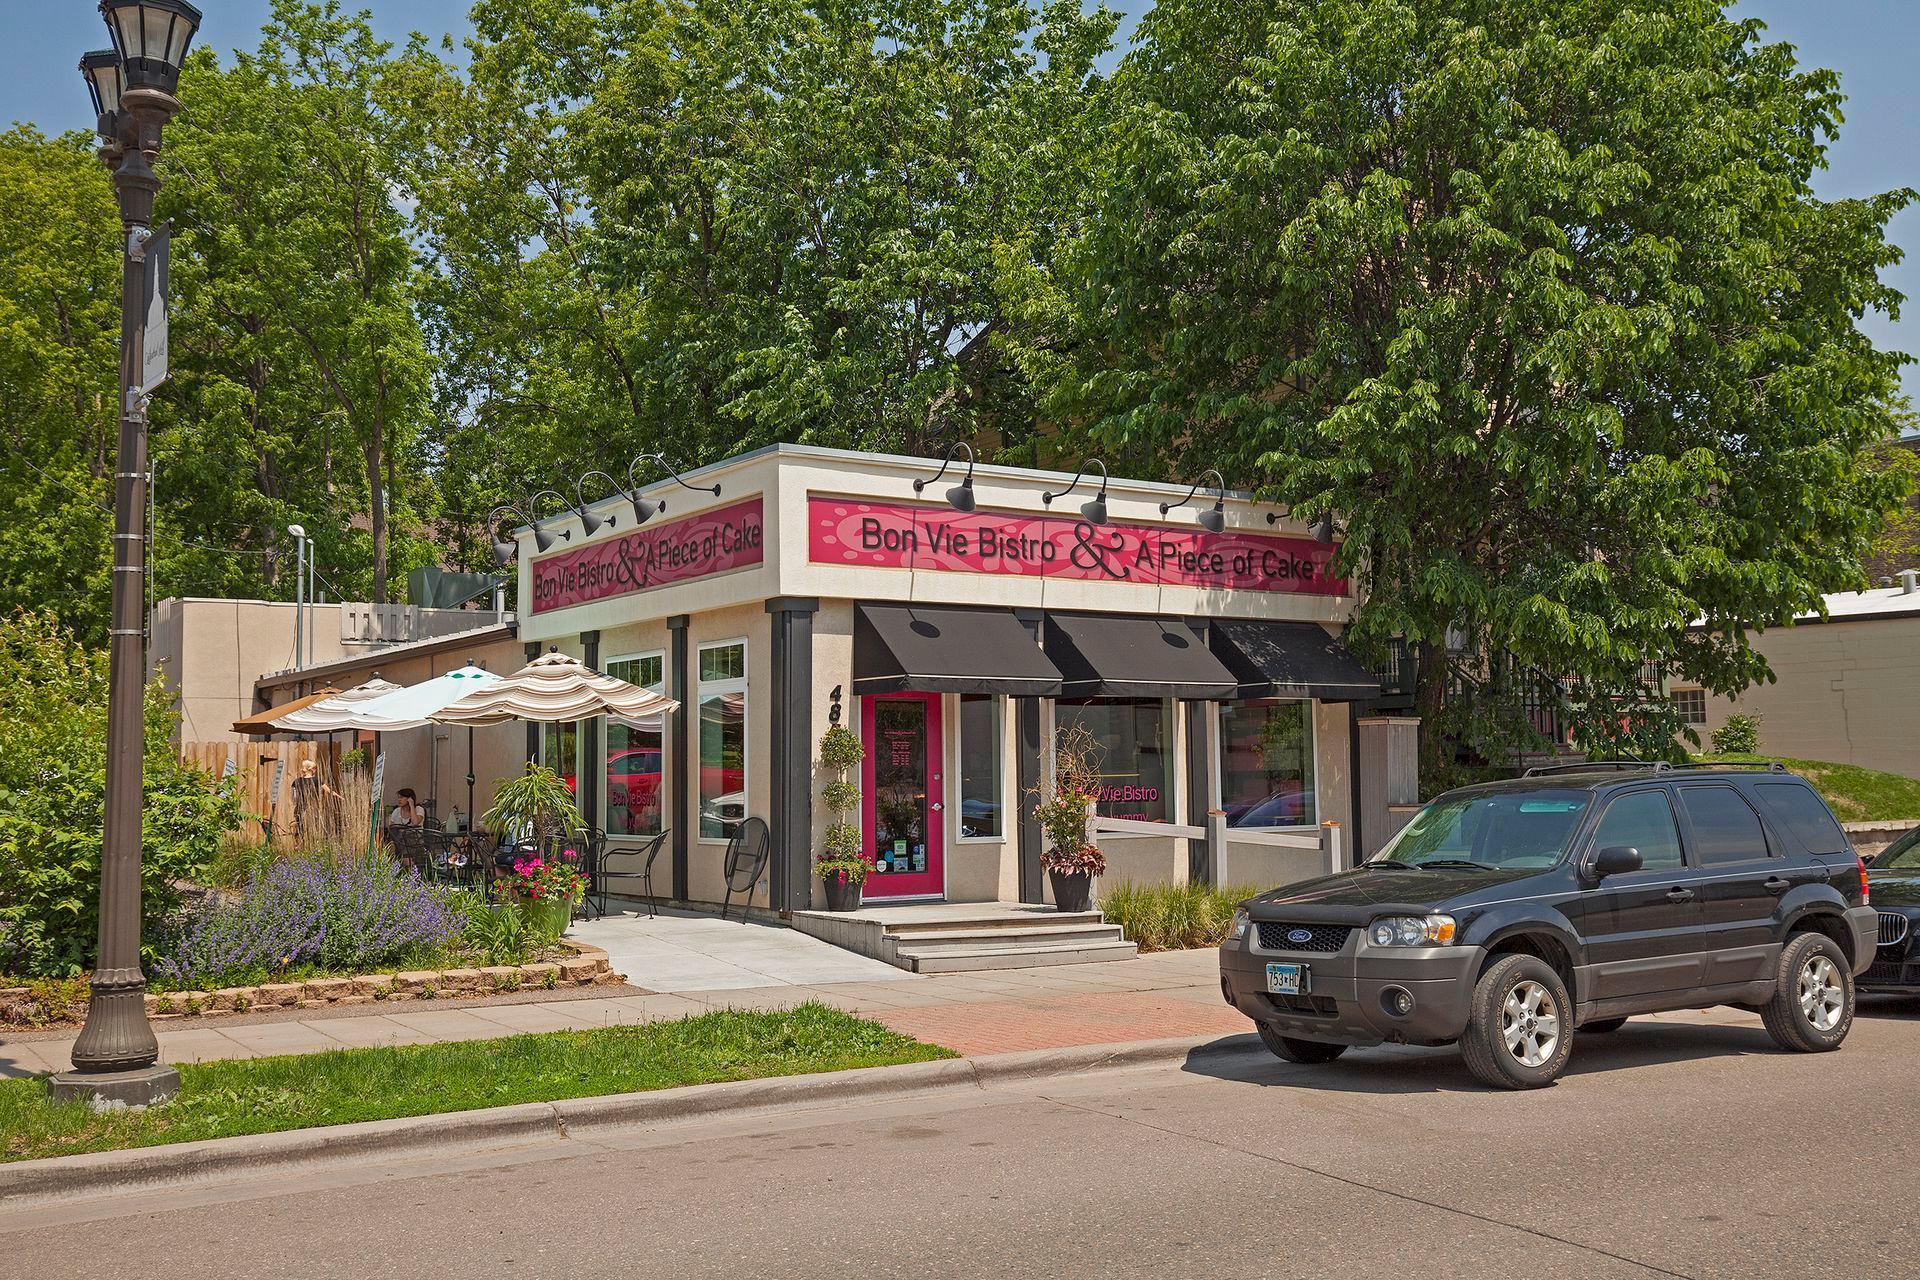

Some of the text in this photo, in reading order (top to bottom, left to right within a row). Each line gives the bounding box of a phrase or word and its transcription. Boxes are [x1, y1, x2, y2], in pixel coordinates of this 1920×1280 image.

[535, 518, 761, 600] Bon Vie Bistro & A Piece of Cake
[861, 517, 1314, 580] Bon Vie Bistro & A Piece of Cake
[1103, 785, 1121, 801] Vie
[1124, 784, 1159, 802] Bistro
[1269, 972, 1284, 987] 753
